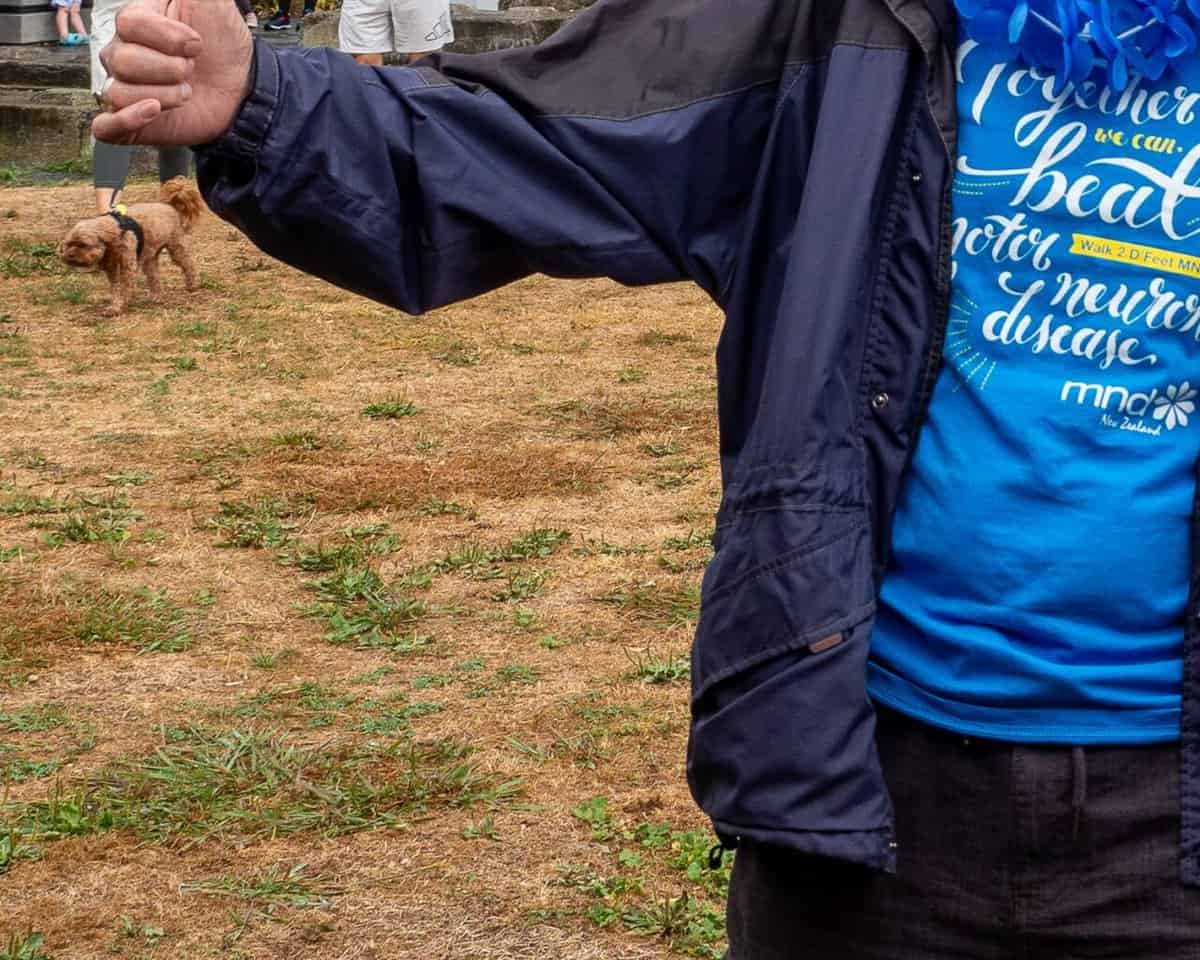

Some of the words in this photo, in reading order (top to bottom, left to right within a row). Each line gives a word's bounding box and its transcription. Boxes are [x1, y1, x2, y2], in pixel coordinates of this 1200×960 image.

[1080, 239, 1112, 256] Walk
[1117, 246, 1127, 257] 2
[982, 271, 1157, 370] disease
[1061, 380, 1158, 417] mnd
